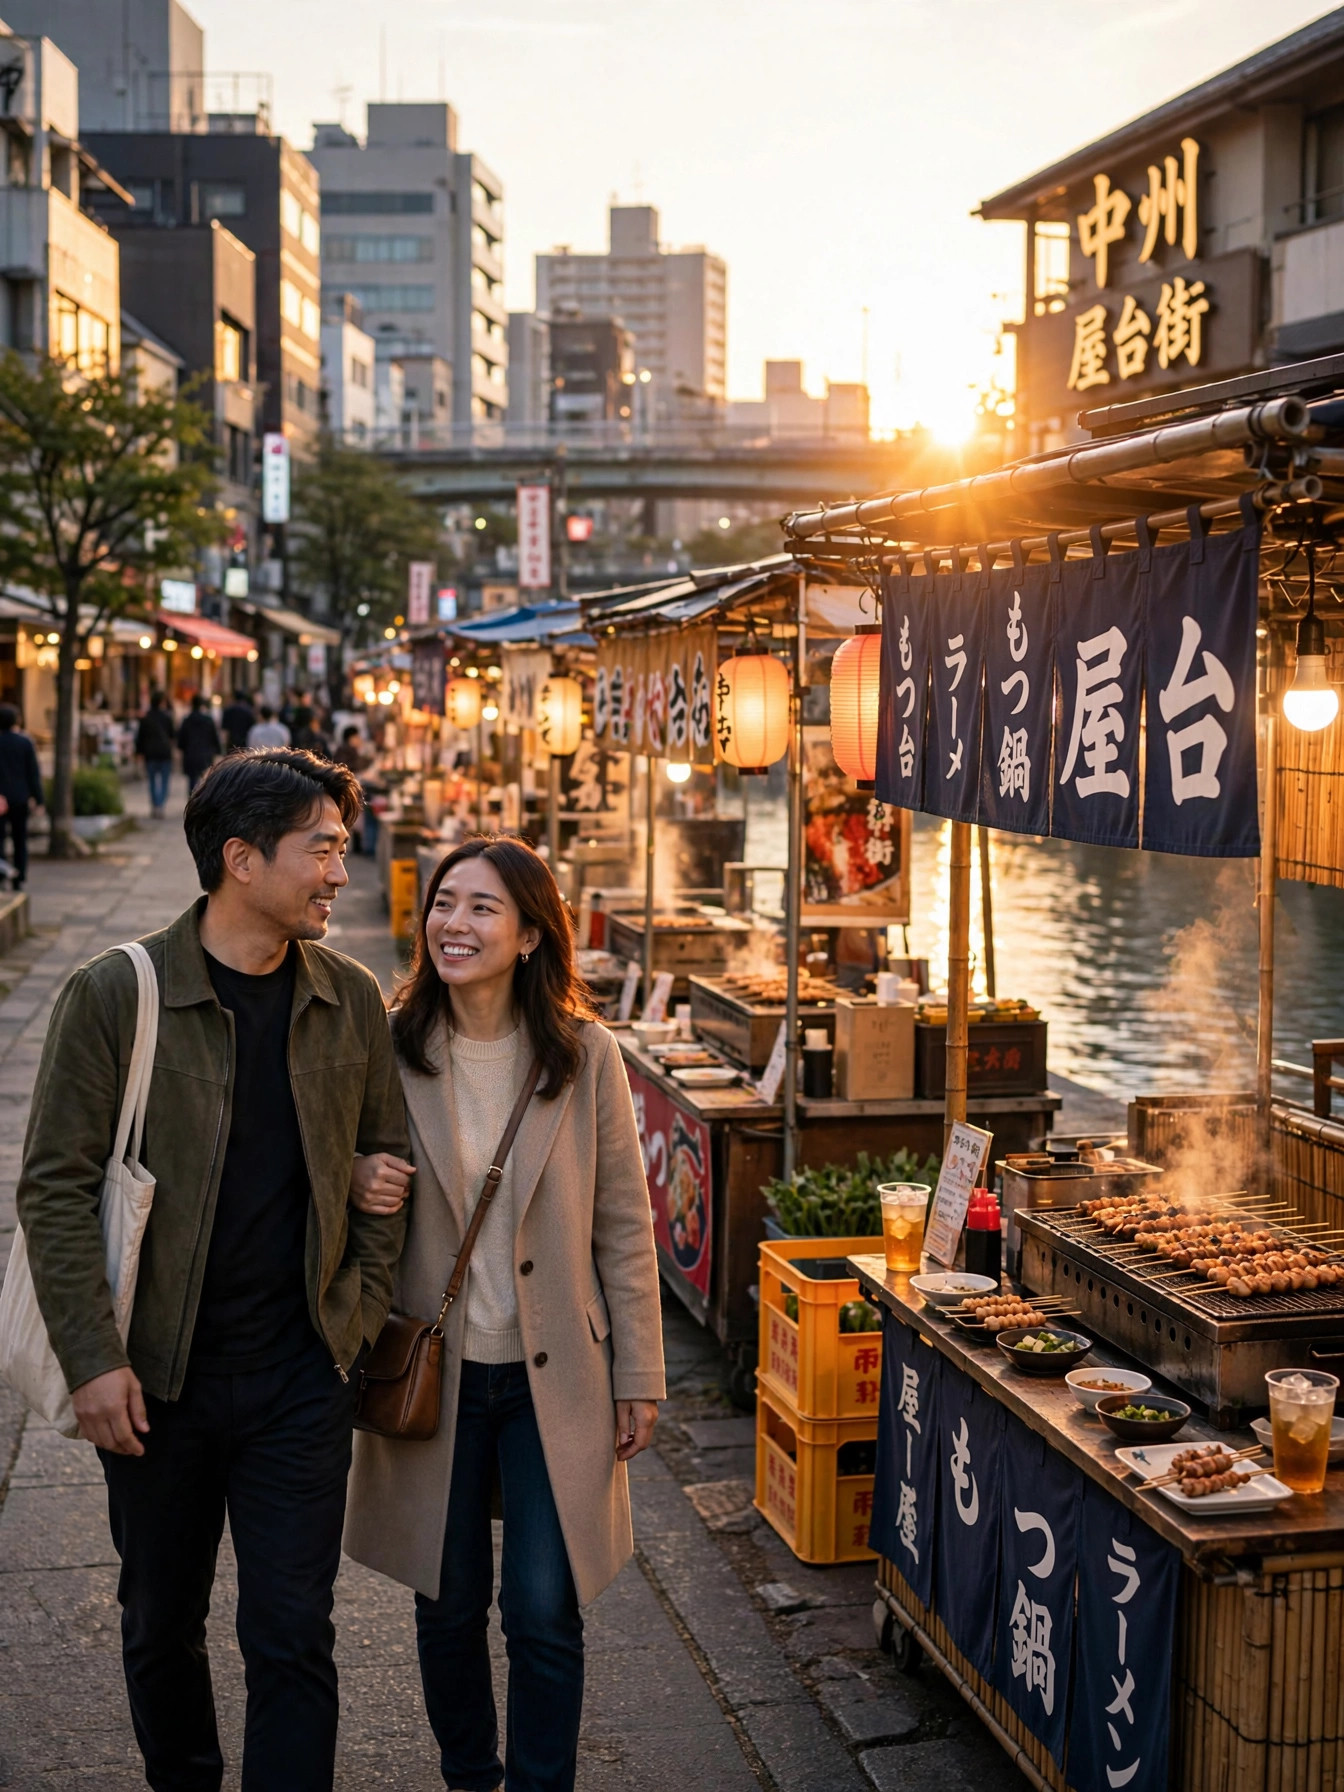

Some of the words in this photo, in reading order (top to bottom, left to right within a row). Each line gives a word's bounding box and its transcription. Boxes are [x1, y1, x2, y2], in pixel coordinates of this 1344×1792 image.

[1077, 137, 1200, 289] 中州
[1066, 276, 1210, 392] 屋台街
[895, 614, 917, 780] もつ台
[944, 632, 968, 781] ラーメ
[996, 589, 1032, 804] もつ鍋
[1105, 1536, 1141, 1790] ラーメン
